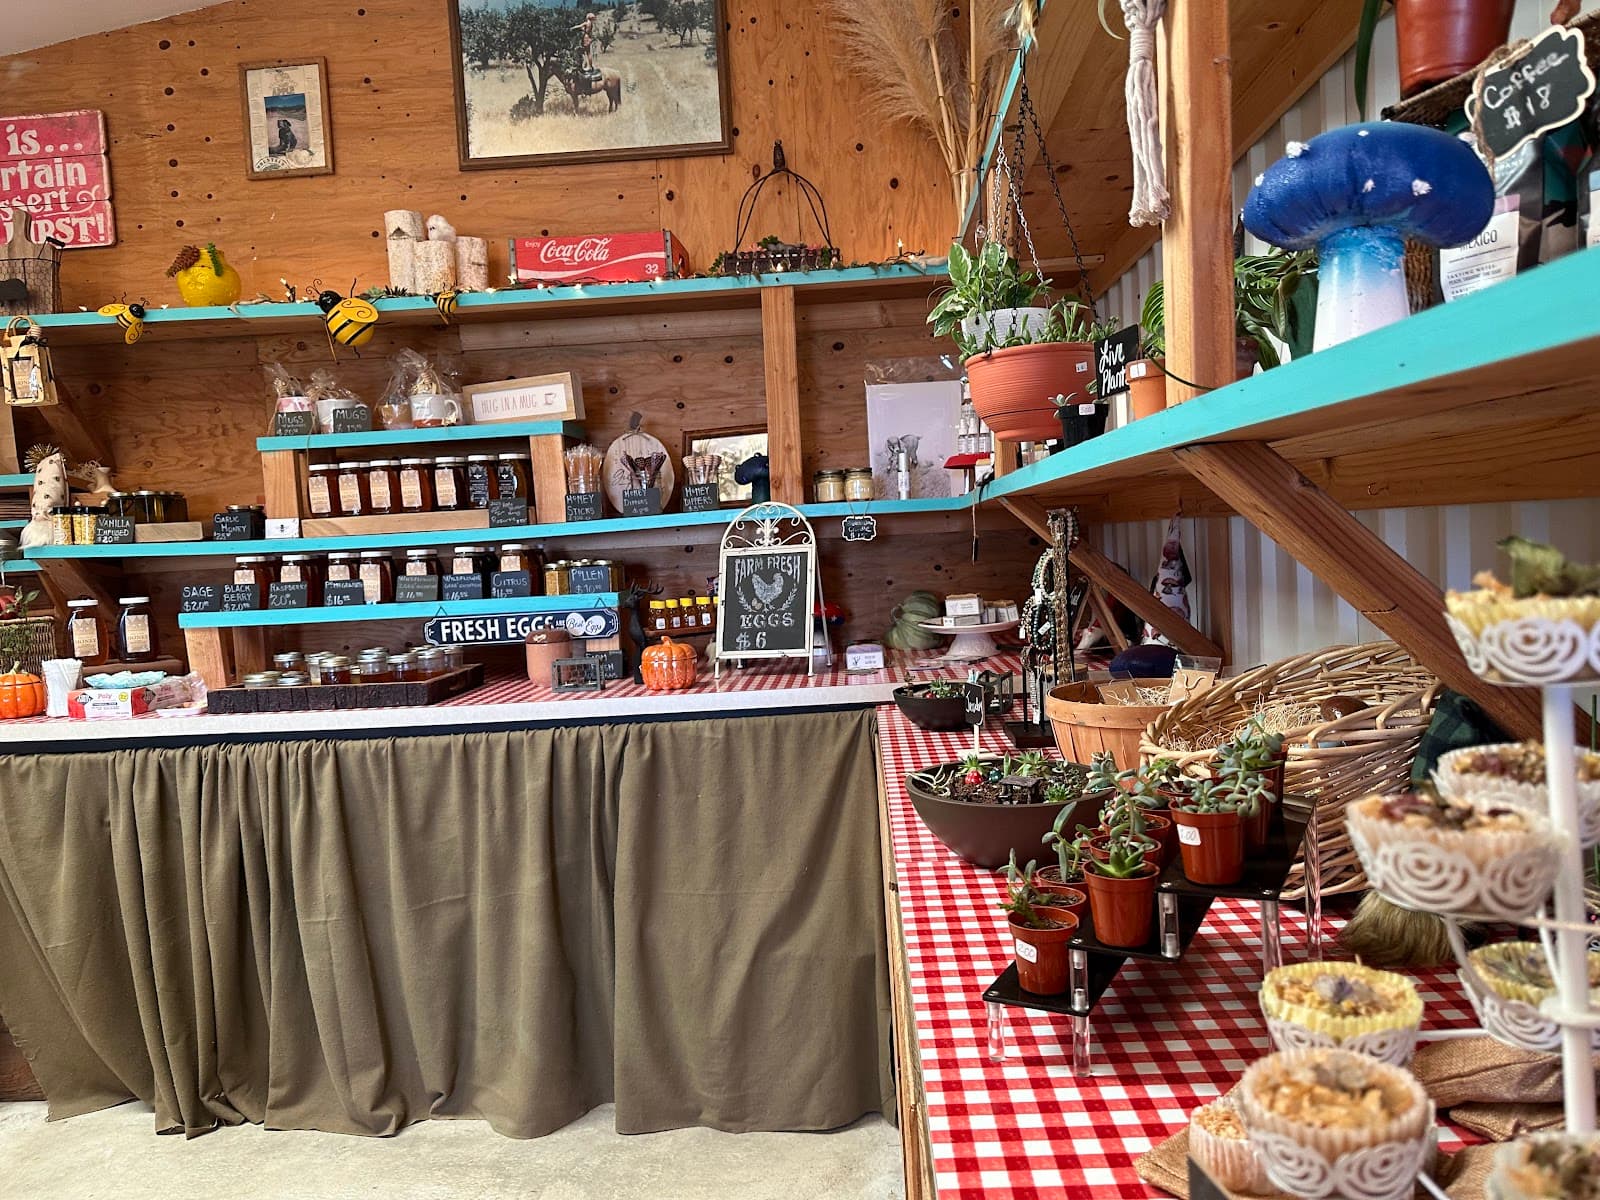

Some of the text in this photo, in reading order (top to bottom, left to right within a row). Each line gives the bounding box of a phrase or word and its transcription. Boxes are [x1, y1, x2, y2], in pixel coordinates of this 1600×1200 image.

[1484, 53, 1569, 109] Coffee
[1461, 229, 1498, 252] EXICO
[645, 264, 659, 274] 32
[1099, 339, 1125, 374] Live
[519, 395, 537, 410] MUG
[278, 413, 304, 425] MUGS
[335, 409, 368, 421] MUGS
[624, 488, 647, 498] HONEY
[685, 486, 710, 497] HONEY
[566, 494, 594, 505] HONEY
[567, 505, 595, 516] STICKS
[98, 517, 131, 528] VANILLA
[214, 513, 240, 523] GARLIC
[221, 523, 247, 533] HONEY
[571, 568, 604, 581] POLLEN
[735, 555, 800, 588] FARM FRESH
[492, 573, 528, 587] CITRUS
[183, 586, 213, 598] SAGE
[224, 584, 251, 593] BLACK
[223, 593, 252, 602] BERRY
[740, 612, 794, 629] EGGS
[441, 618, 499, 642] FRESH
[586, 620, 602, 633] Eggs
